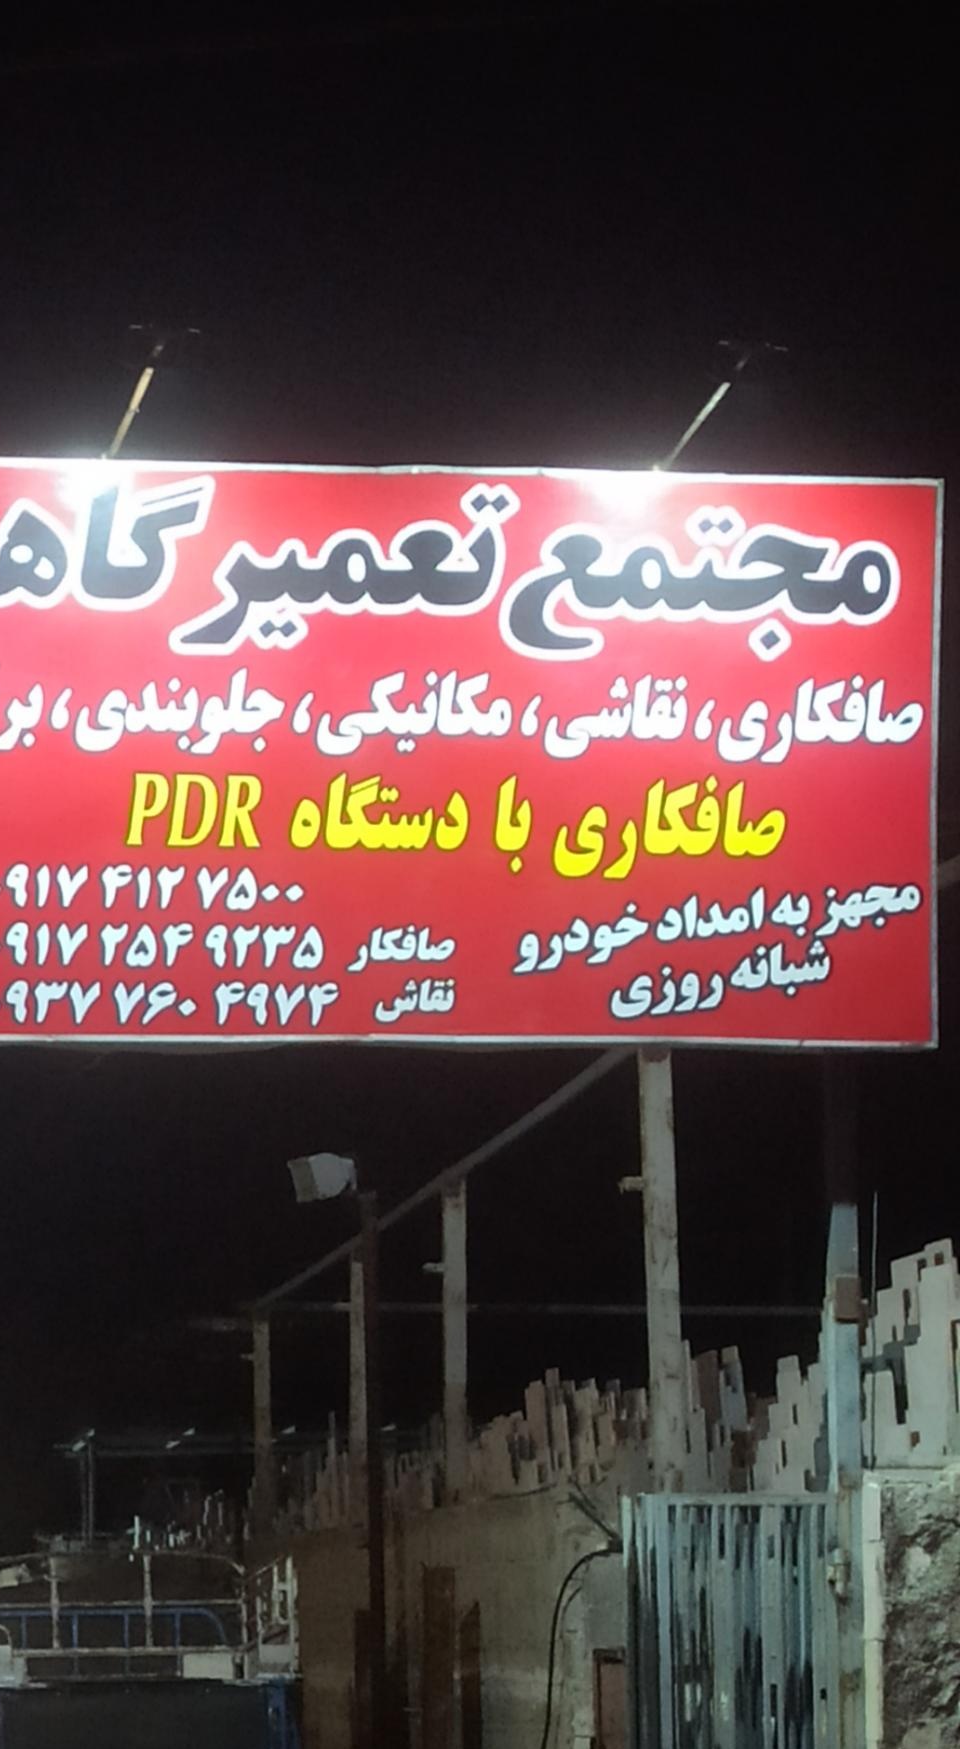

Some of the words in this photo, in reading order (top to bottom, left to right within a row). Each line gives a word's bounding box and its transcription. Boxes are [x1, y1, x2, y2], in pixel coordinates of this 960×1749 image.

[499, 495, 900, 661] مجتمع
[126, 771, 263, 848] PDR
[288, 773, 470, 852] دستگاه
[493, 774, 533, 874] با
[552, 775, 787, 879] صافکاری
[100, 864, 186, 909] ۴۱۲
[197, 866, 305, 911] ۷۵۰۰
[655, 886, 766, 942] امداد
[769, 889, 811, 938] به
[815, 880, 922, 937] مجهز
[100, 922, 195, 968] ۲۵۴
[204, 923, 324, 969] ۹۲۳۵
[346, 925, 456, 972] صافکار
[513, 901, 649, 974] خودرو
[609, 965, 725, 1019] روزی
[730, 939, 831, 996] شبانه
[113, 980, 197, 1026] ۷۶۰
[214, 981, 340, 1028] ۴۹۷۴
[372, 977, 456, 1022] نقاش
